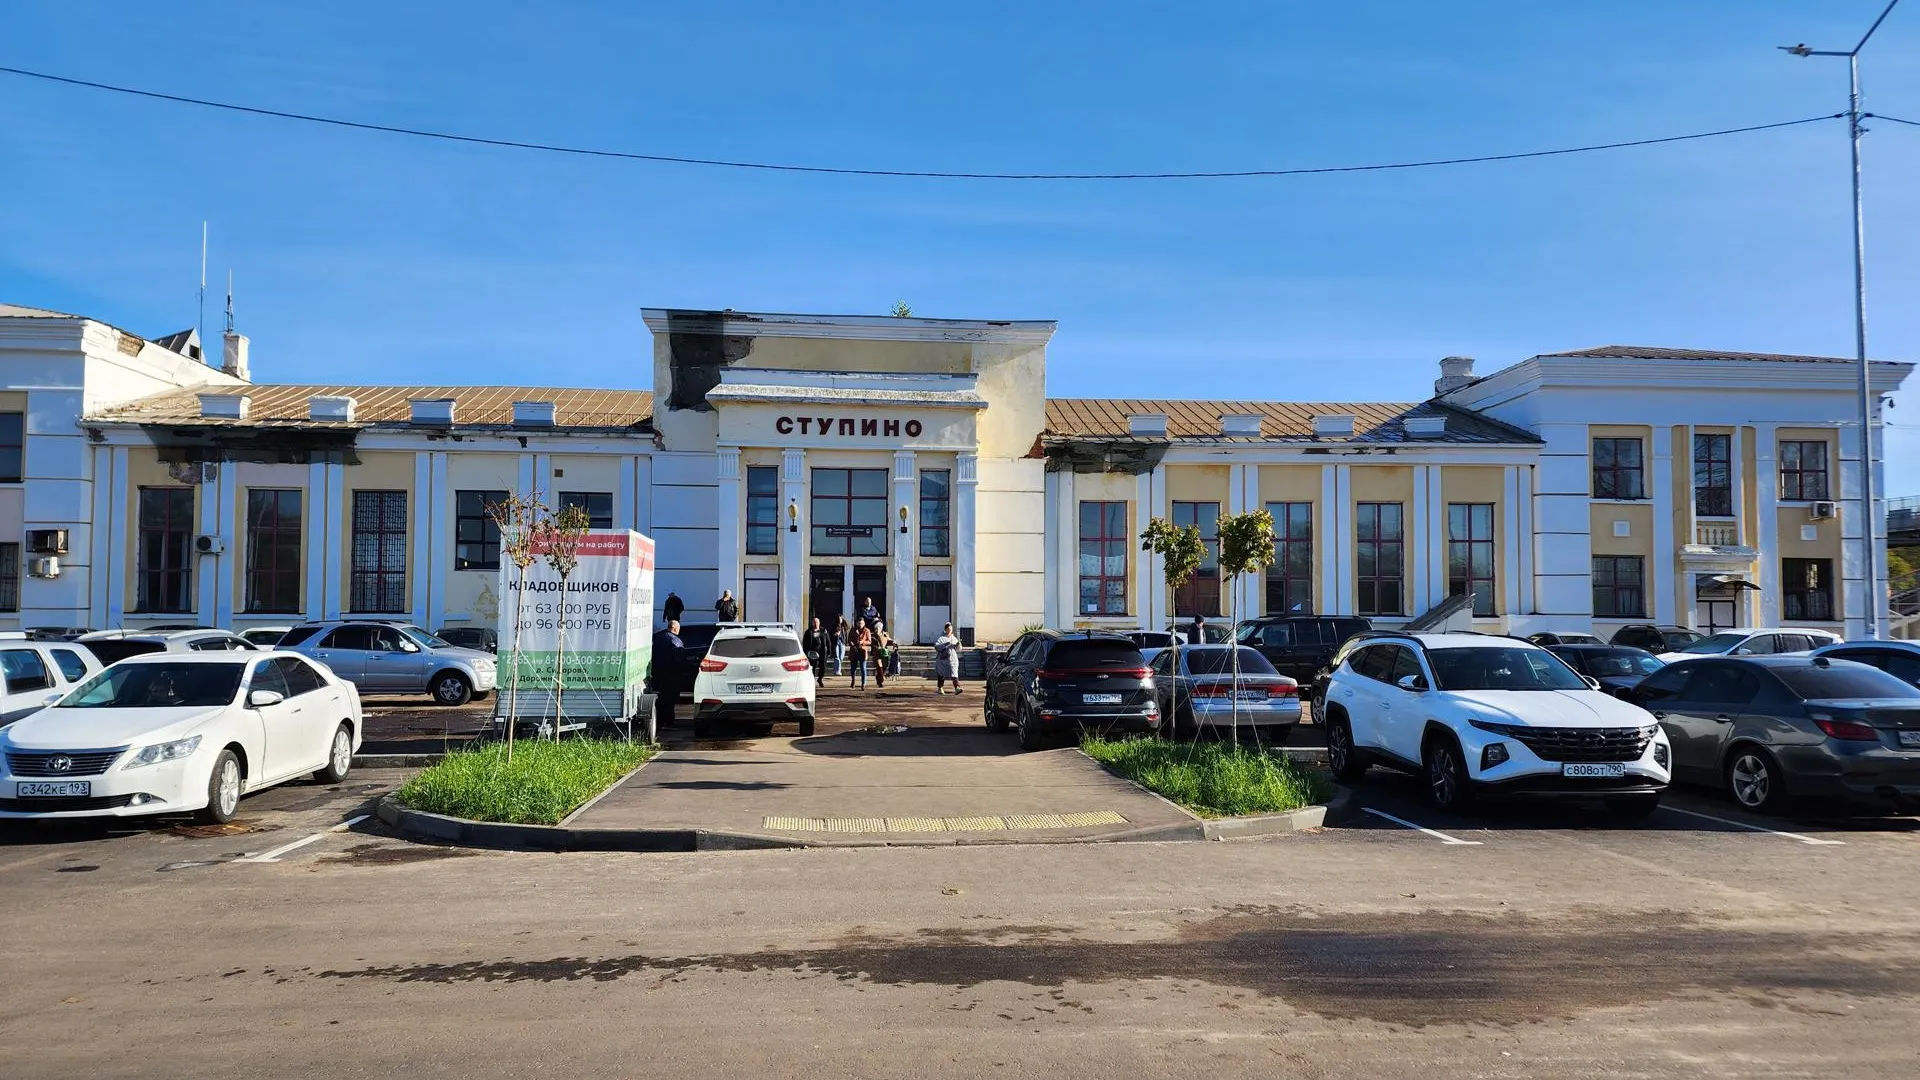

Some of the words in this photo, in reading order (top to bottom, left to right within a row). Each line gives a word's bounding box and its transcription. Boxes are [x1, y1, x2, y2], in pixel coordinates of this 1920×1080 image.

[776, 416, 923, 438] СТУПИНО
[597, 541, 625, 550] работу
[535, 603, 552, 614] 63
[586, 603, 611, 614] РУБ
[536, 619, 553, 630] 96
[586, 619, 611, 630] РУБ
[1566, 765, 1605, 775] С808ОТ
[1607, 764, 1622, 773] 790
[21, 783, 66, 795] С342КЕ
[68, 782, 88, 792] 193
